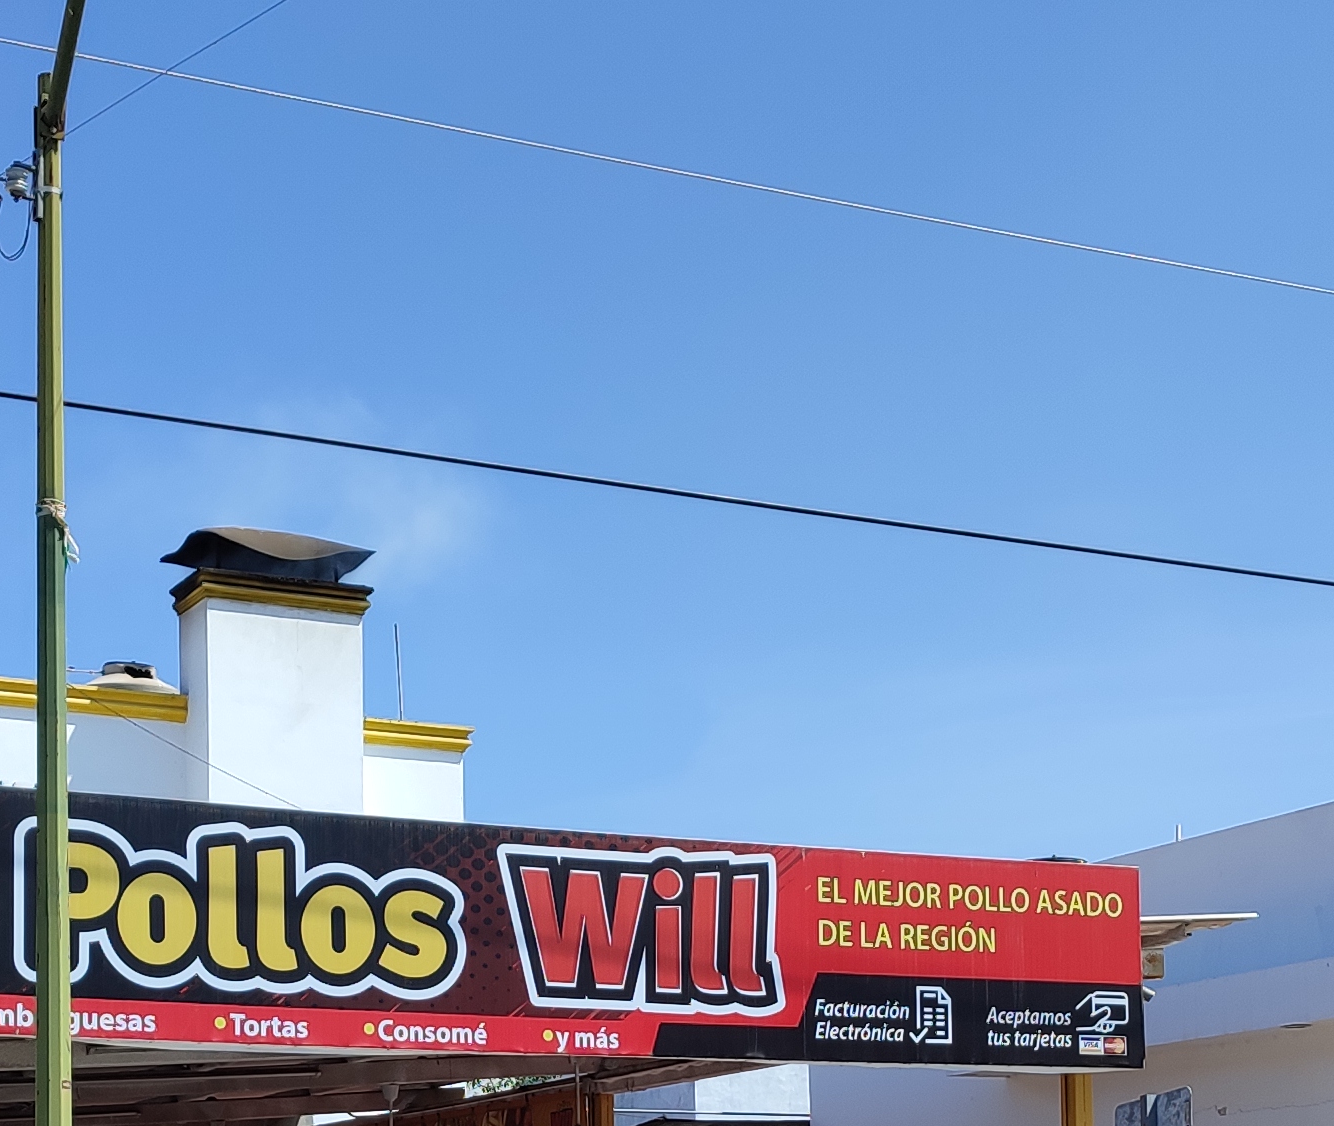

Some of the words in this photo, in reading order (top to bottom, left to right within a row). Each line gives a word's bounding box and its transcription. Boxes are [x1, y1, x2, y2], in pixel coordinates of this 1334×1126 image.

[816, 876, 847, 905] EL
[853, 878, 942, 910] MEJOR
[948, 883, 1030, 914] POLLO
[1036, 889, 1124, 918] ASADO
[41, 838, 450, 983] Pollos
[514, 858, 771, 1002] Will
[817, 919, 853, 948] DE
[860, 921, 893, 950] LA
[900, 920, 997, 954] REGIÓN
[814, 998, 911, 1022] Facturación
[985, 1006, 1072, 1029] Aceptamos
[229, 1011, 309, 1039] Tortas
[377, 1016, 488, 1046] Consomé
[554, 1028, 571, 1053] y
[574, 1025, 620, 1050] más
[814, 1021, 905, 1043] Electrónica
[987, 1031, 1011, 1048] tus
[1013, 1030, 1073, 1051] tarjetas
[1083, 1041, 1099, 1049] VISA
